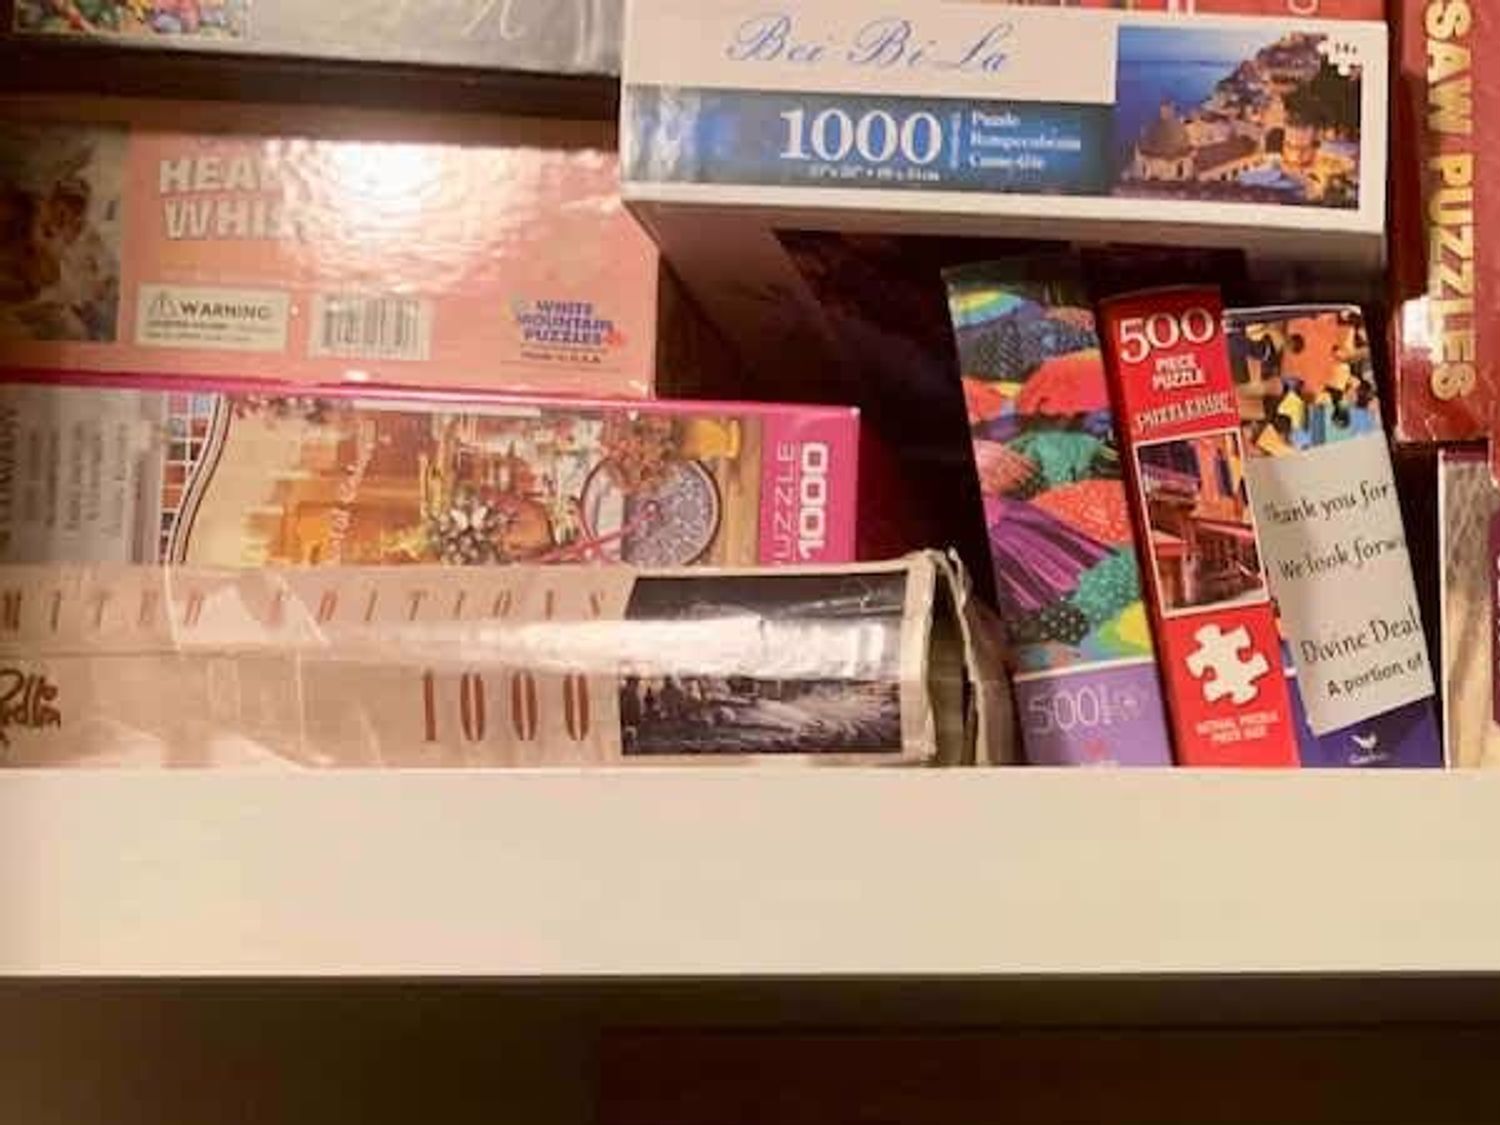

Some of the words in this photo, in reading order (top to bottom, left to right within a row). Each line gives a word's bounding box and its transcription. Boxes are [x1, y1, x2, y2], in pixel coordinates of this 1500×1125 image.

[780, 108, 943, 164] 1000
[1428, 152, 1477, 400] PUZZLES
[180, 302, 273, 322] WARNING
[1120, 307, 1214, 364] 500
[771, 439, 798, 565] UZZLE
[798, 441, 830, 561] 1000
[1320, 494, 1358, 521] you
[1360, 479, 1391, 507] for
[1300, 633, 1367, 664] Divine
[422, 668, 593, 744] 1000
[1327, 679, 1341, 698] A
[1344, 662, 1404, 695] portion
